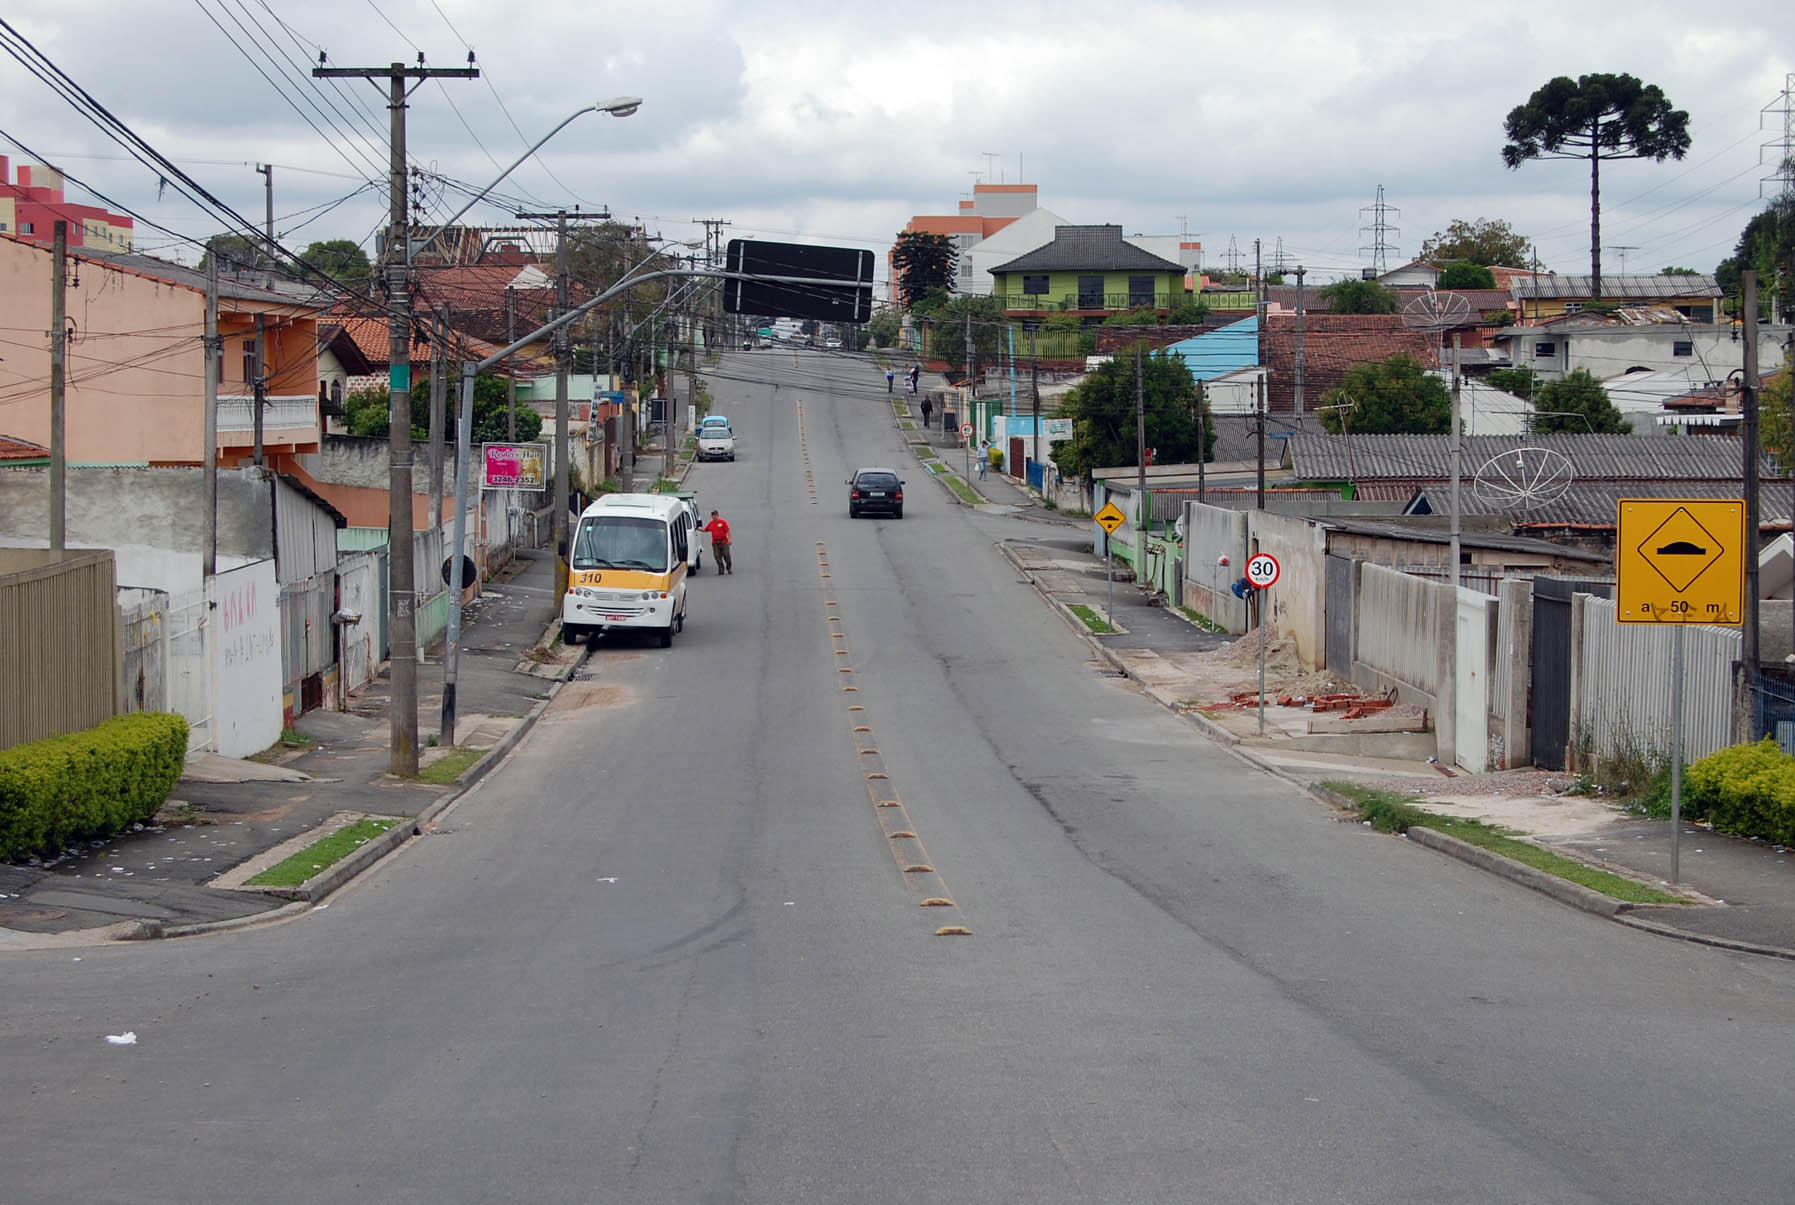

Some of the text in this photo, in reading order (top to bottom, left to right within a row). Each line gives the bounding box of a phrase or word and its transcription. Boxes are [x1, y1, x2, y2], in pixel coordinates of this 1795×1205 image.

[1251, 561, 1274, 576] 30
[579, 573, 602, 584] 310
[1641, 602, 1650, 613] a
[1670, 601, 1689, 613] 50
[1706, 602, 1720, 613] m
